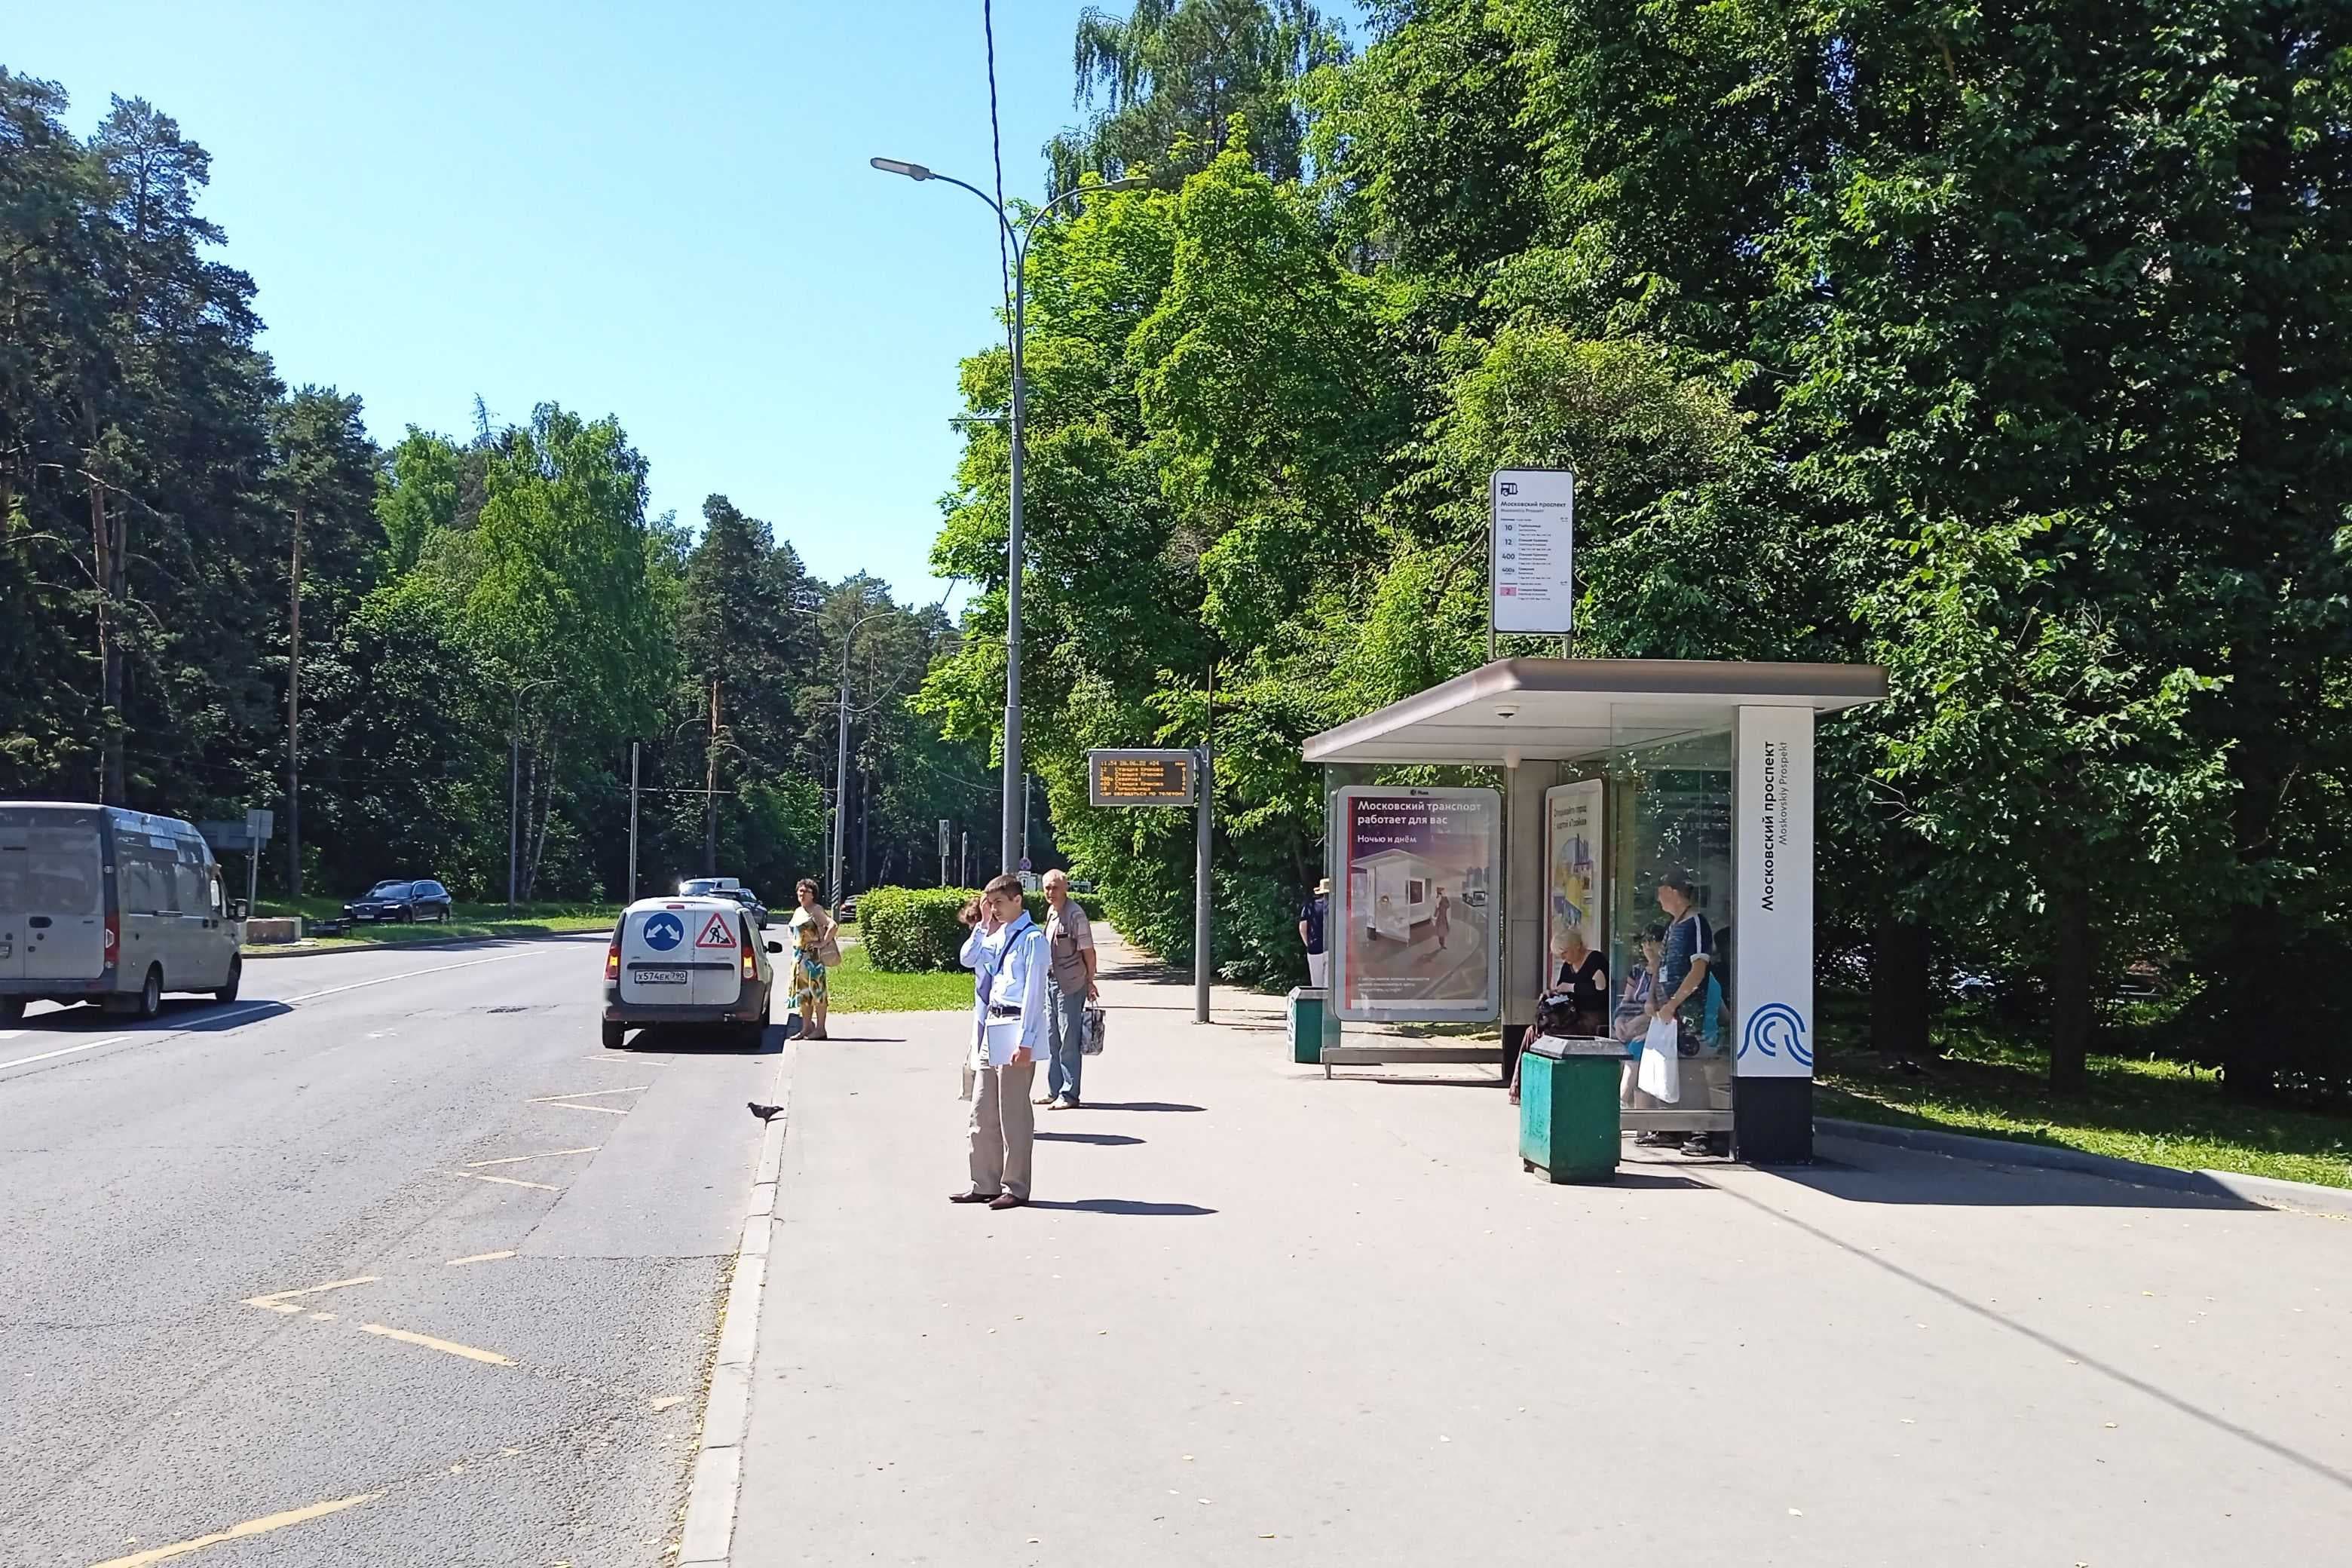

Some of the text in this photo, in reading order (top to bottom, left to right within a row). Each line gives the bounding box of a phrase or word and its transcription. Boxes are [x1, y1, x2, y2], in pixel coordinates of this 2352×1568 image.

[1779, 742, 1789, 845] Moskovskiy Prospekt
[1358, 801, 1481, 812] Московский транспорт
[1358, 815, 1407, 825] работает
[1430, 816, 1447, 825] вас
[1761, 741, 1777, 911] Московский проспект
[1357, 835, 1386, 843] Ночью
[1394, 835, 1417, 844] днём
